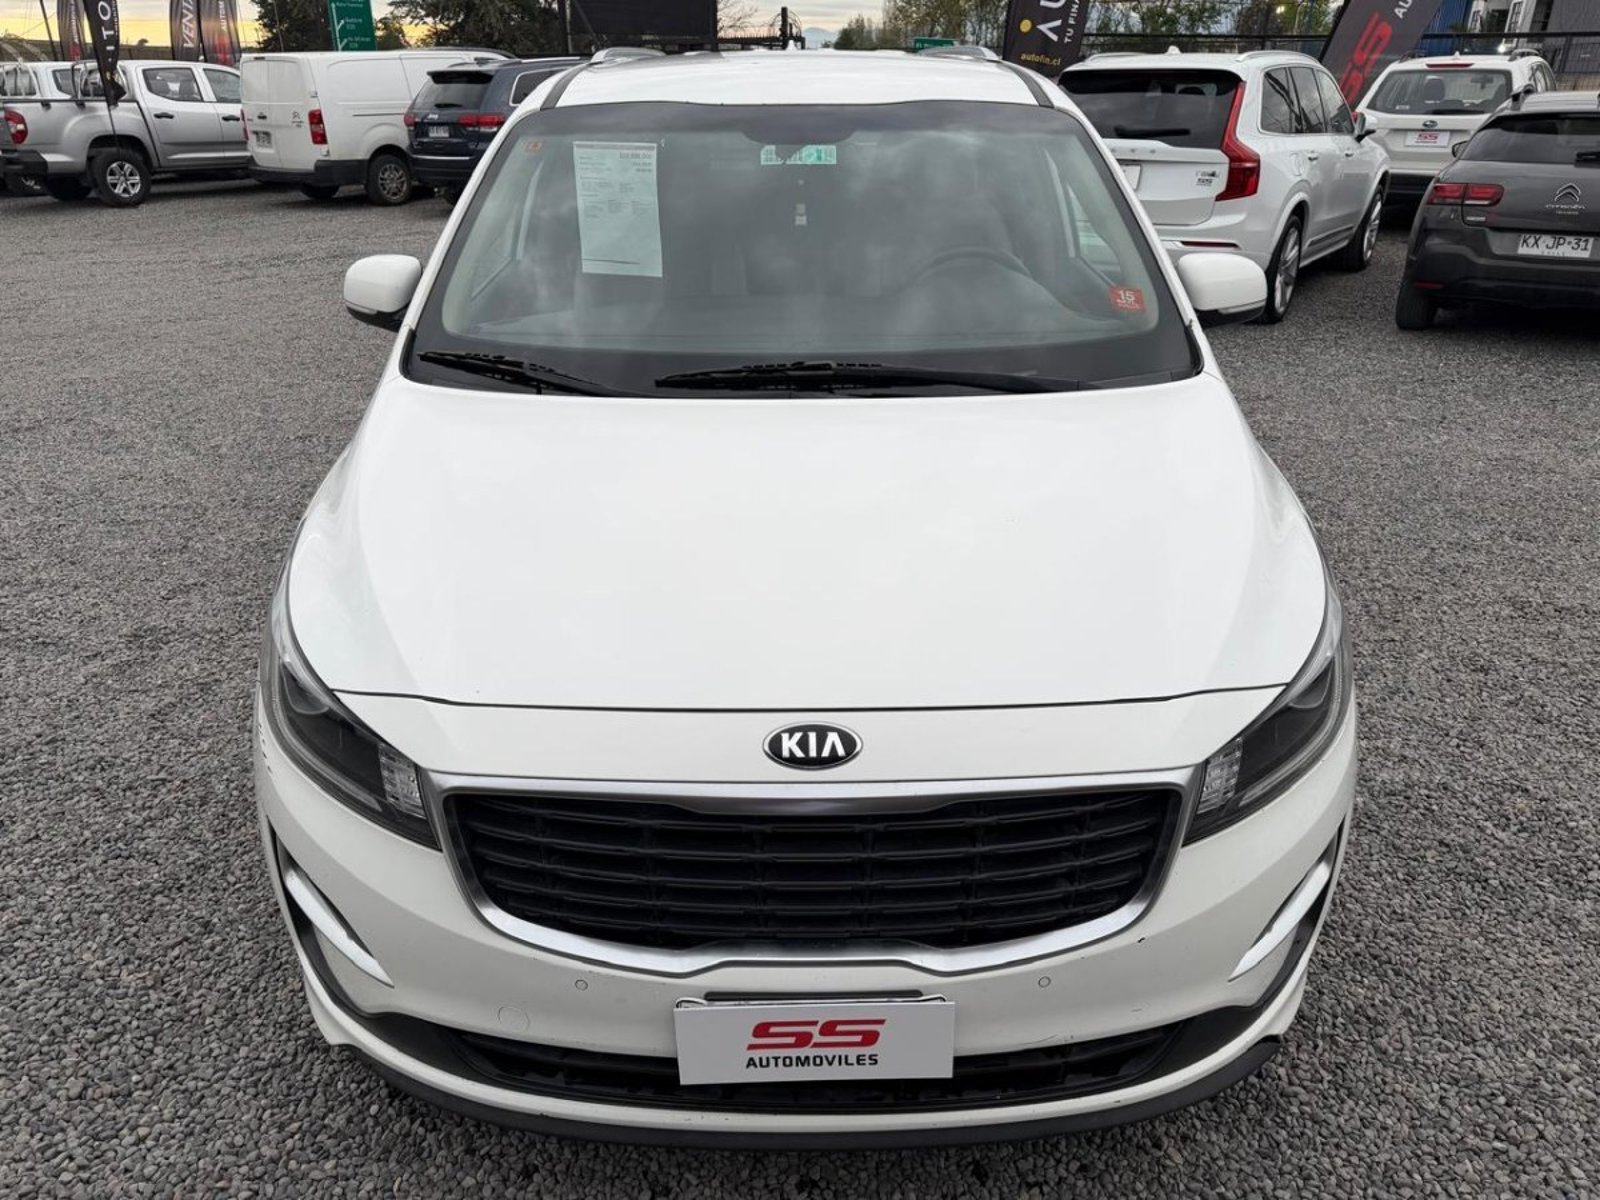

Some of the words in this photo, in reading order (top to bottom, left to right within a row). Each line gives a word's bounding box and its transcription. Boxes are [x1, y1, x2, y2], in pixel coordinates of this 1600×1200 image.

[1063, 27, 1075, 43] TU
[1020, 53, 1062, 65] autofin.cl
[780, 731, 847, 758] KIA
[746, 1018, 887, 1051] SS
[745, 1054, 880, 1069] AUTOMOVILES
